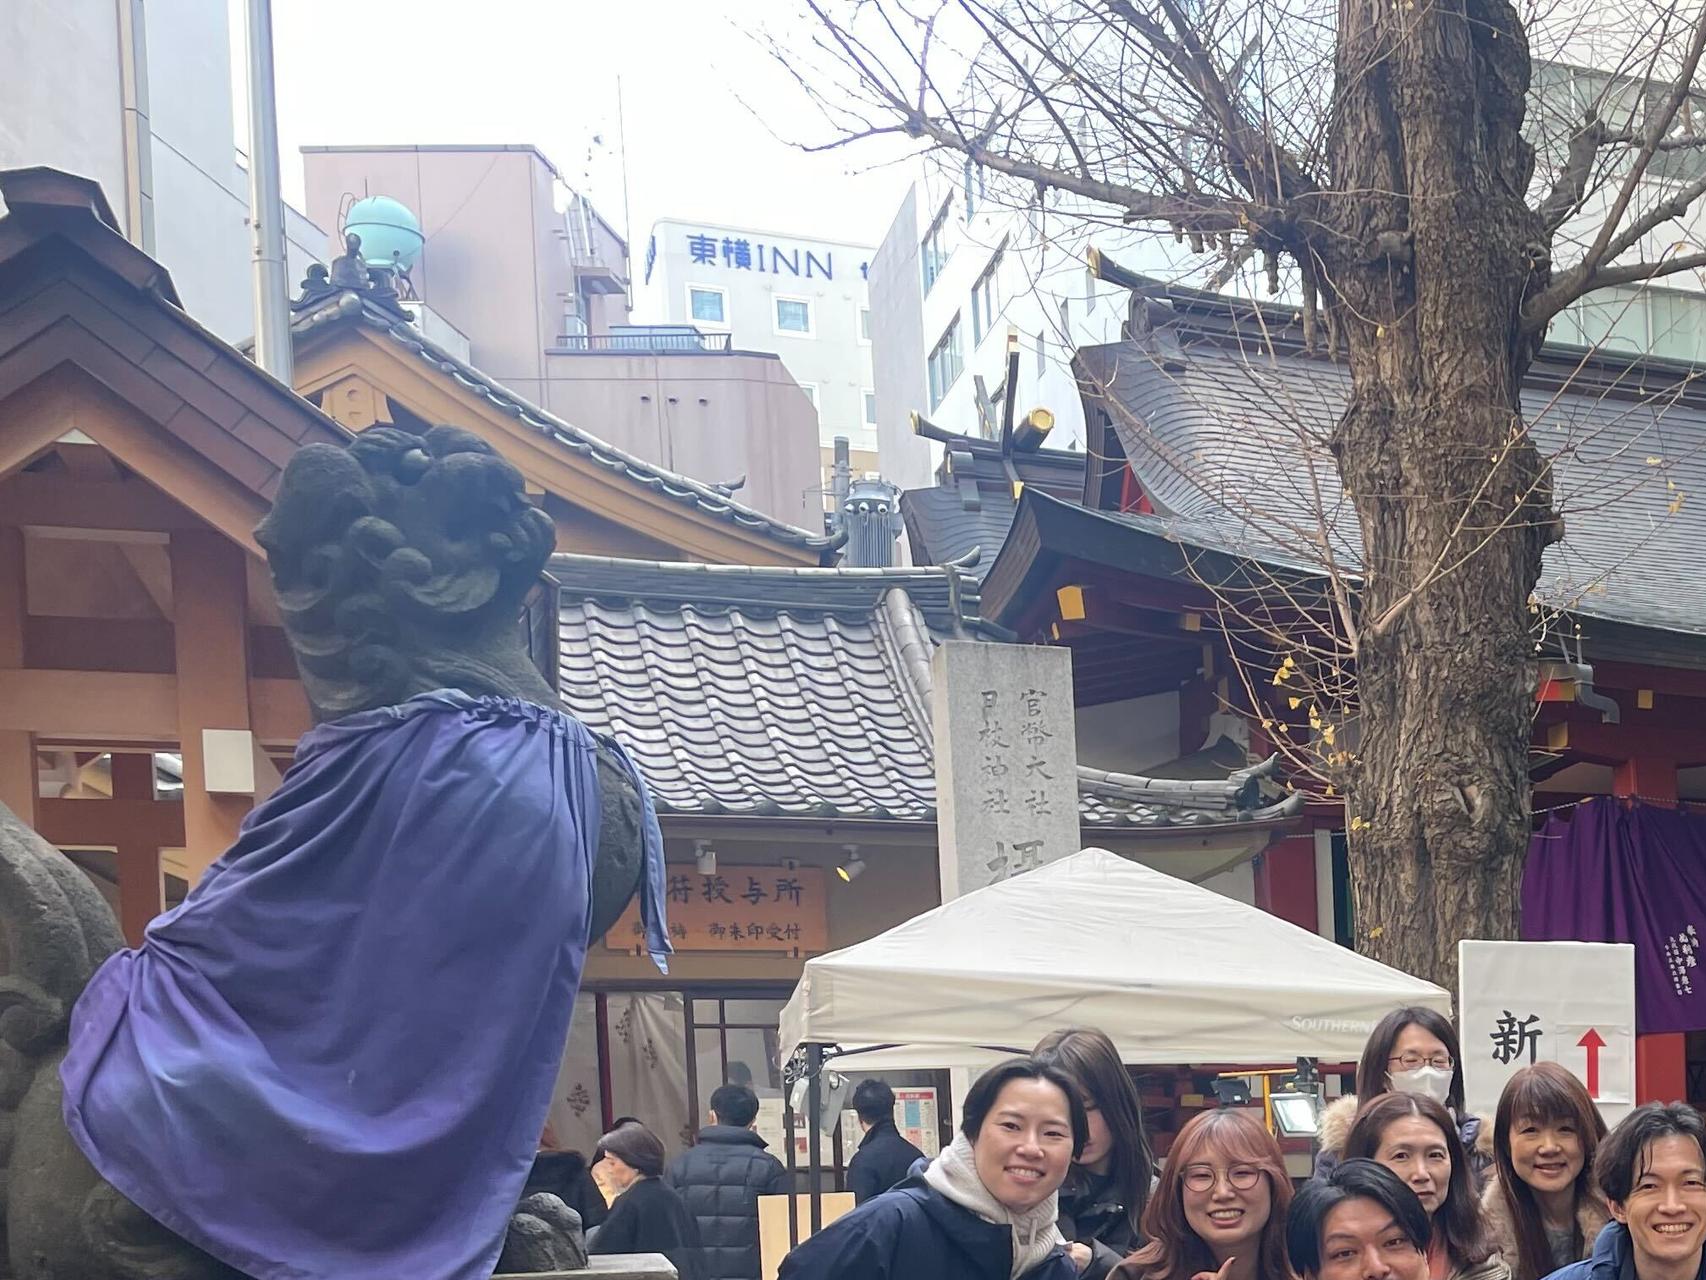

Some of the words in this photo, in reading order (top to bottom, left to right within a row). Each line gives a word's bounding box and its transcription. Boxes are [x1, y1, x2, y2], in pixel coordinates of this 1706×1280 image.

[686, 233, 833, 280] 東横INN
[1291, 1015, 1375, 1034] SOUTHERN
[1489, 1010, 1543, 1066] 新
